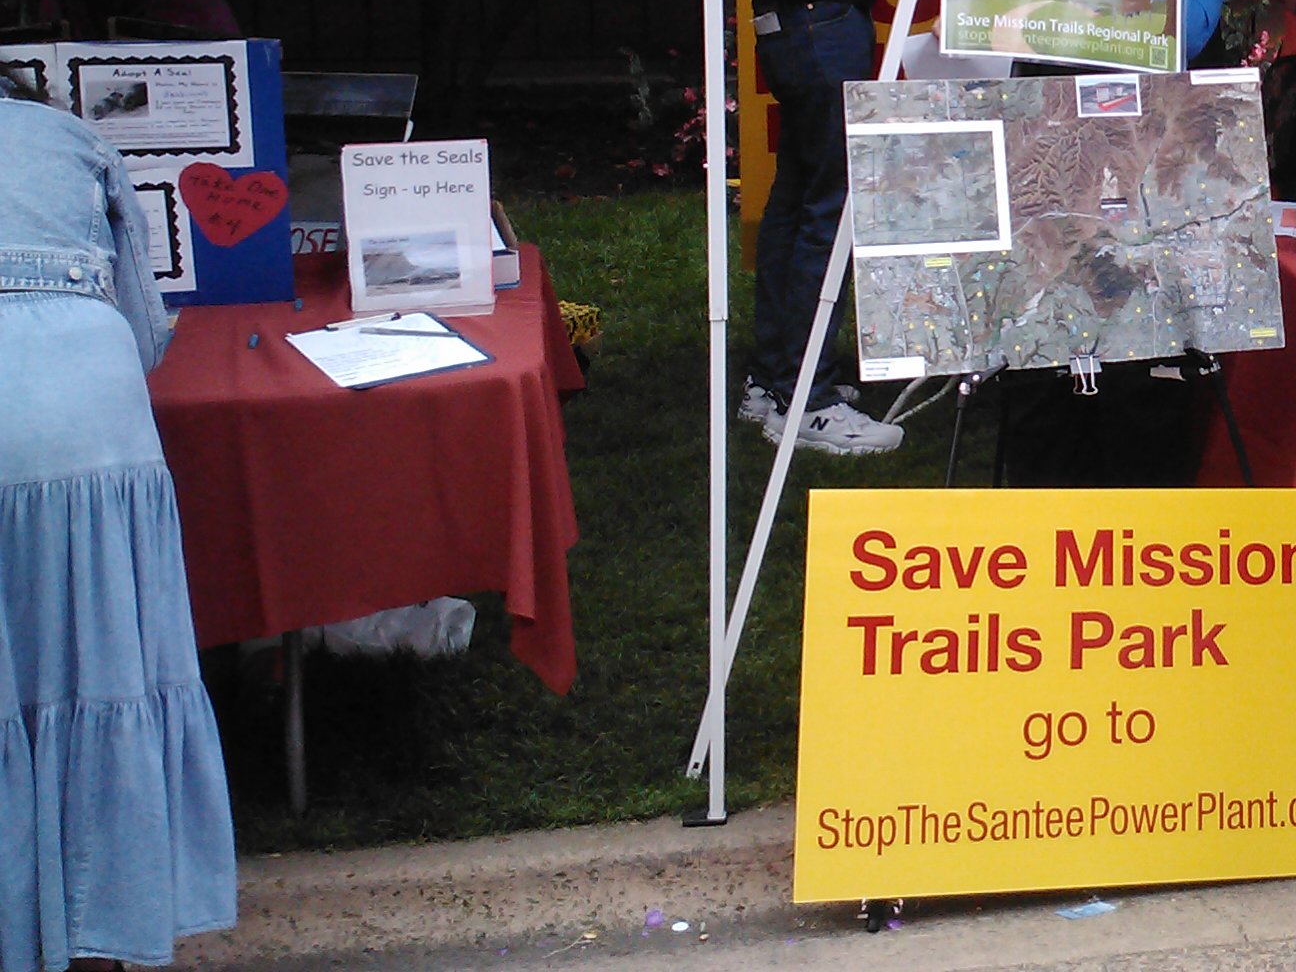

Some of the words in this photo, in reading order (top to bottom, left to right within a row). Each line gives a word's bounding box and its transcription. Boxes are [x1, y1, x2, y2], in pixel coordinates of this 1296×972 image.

[957, 12, 989, 28] Save
[993, 15, 1046, 31] Mission
[1049, 18, 1084, 35] Trails
[1088, 22, 1141, 42] Regional
[1143, 33, 1168, 48] Park
[154, 68, 162, 76] A
[352, 152, 394, 167] Save
[400, 150, 430, 165] the
[436, 149, 483, 164] Seals
[363, 183, 397, 199] Sign
[413, 184, 431, 197] up
[436, 181, 474, 195] Here
[810, 416, 829, 431] N
[849, 530, 1028, 591] Save
[847, 613, 1043, 676] Trails
[1069, 608, 1229, 670] Park
[1022, 710, 1088, 761] go
[1105, 701, 1157, 745] to
